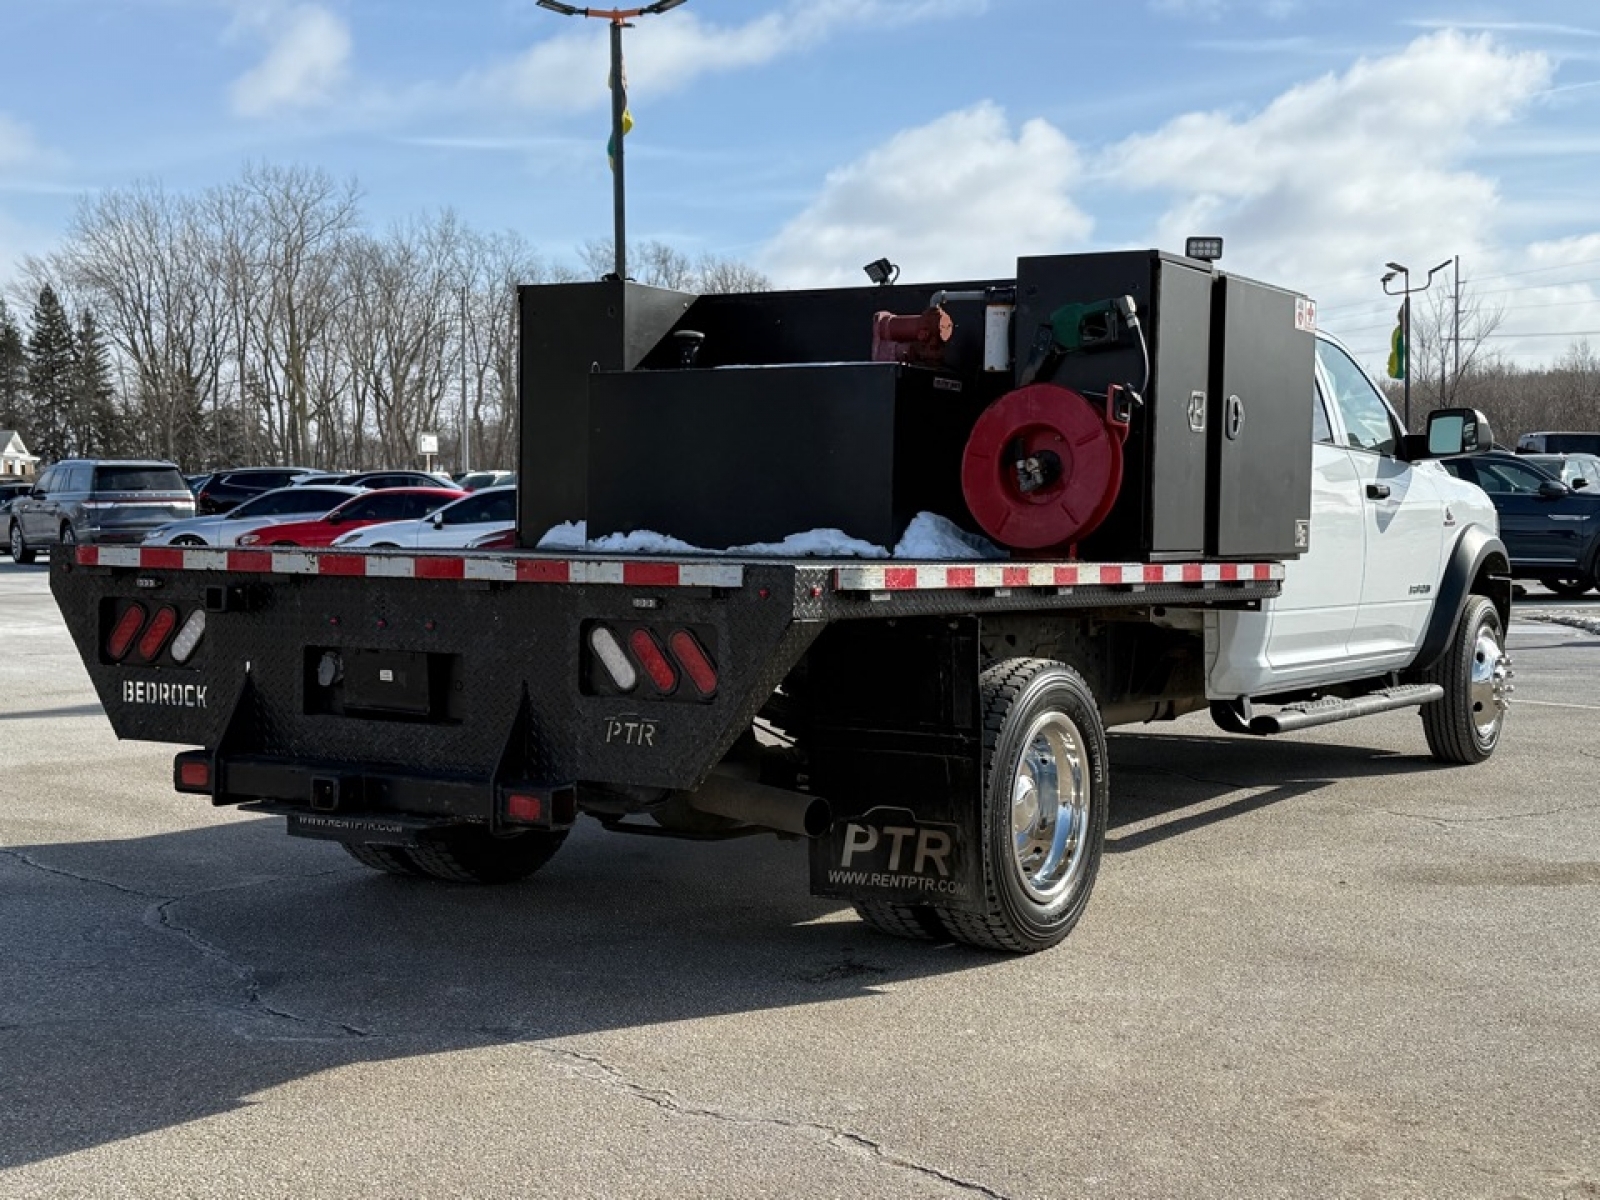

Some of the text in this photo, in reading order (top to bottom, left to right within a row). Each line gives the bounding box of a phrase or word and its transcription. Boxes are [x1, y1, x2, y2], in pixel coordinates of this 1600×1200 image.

[122, 680, 207, 708] BEDROCK
[606, 721, 655, 747] PTR
[841, 823, 950, 876] PTR
[828, 869, 967, 896] WWW.RENTPTR.COM
